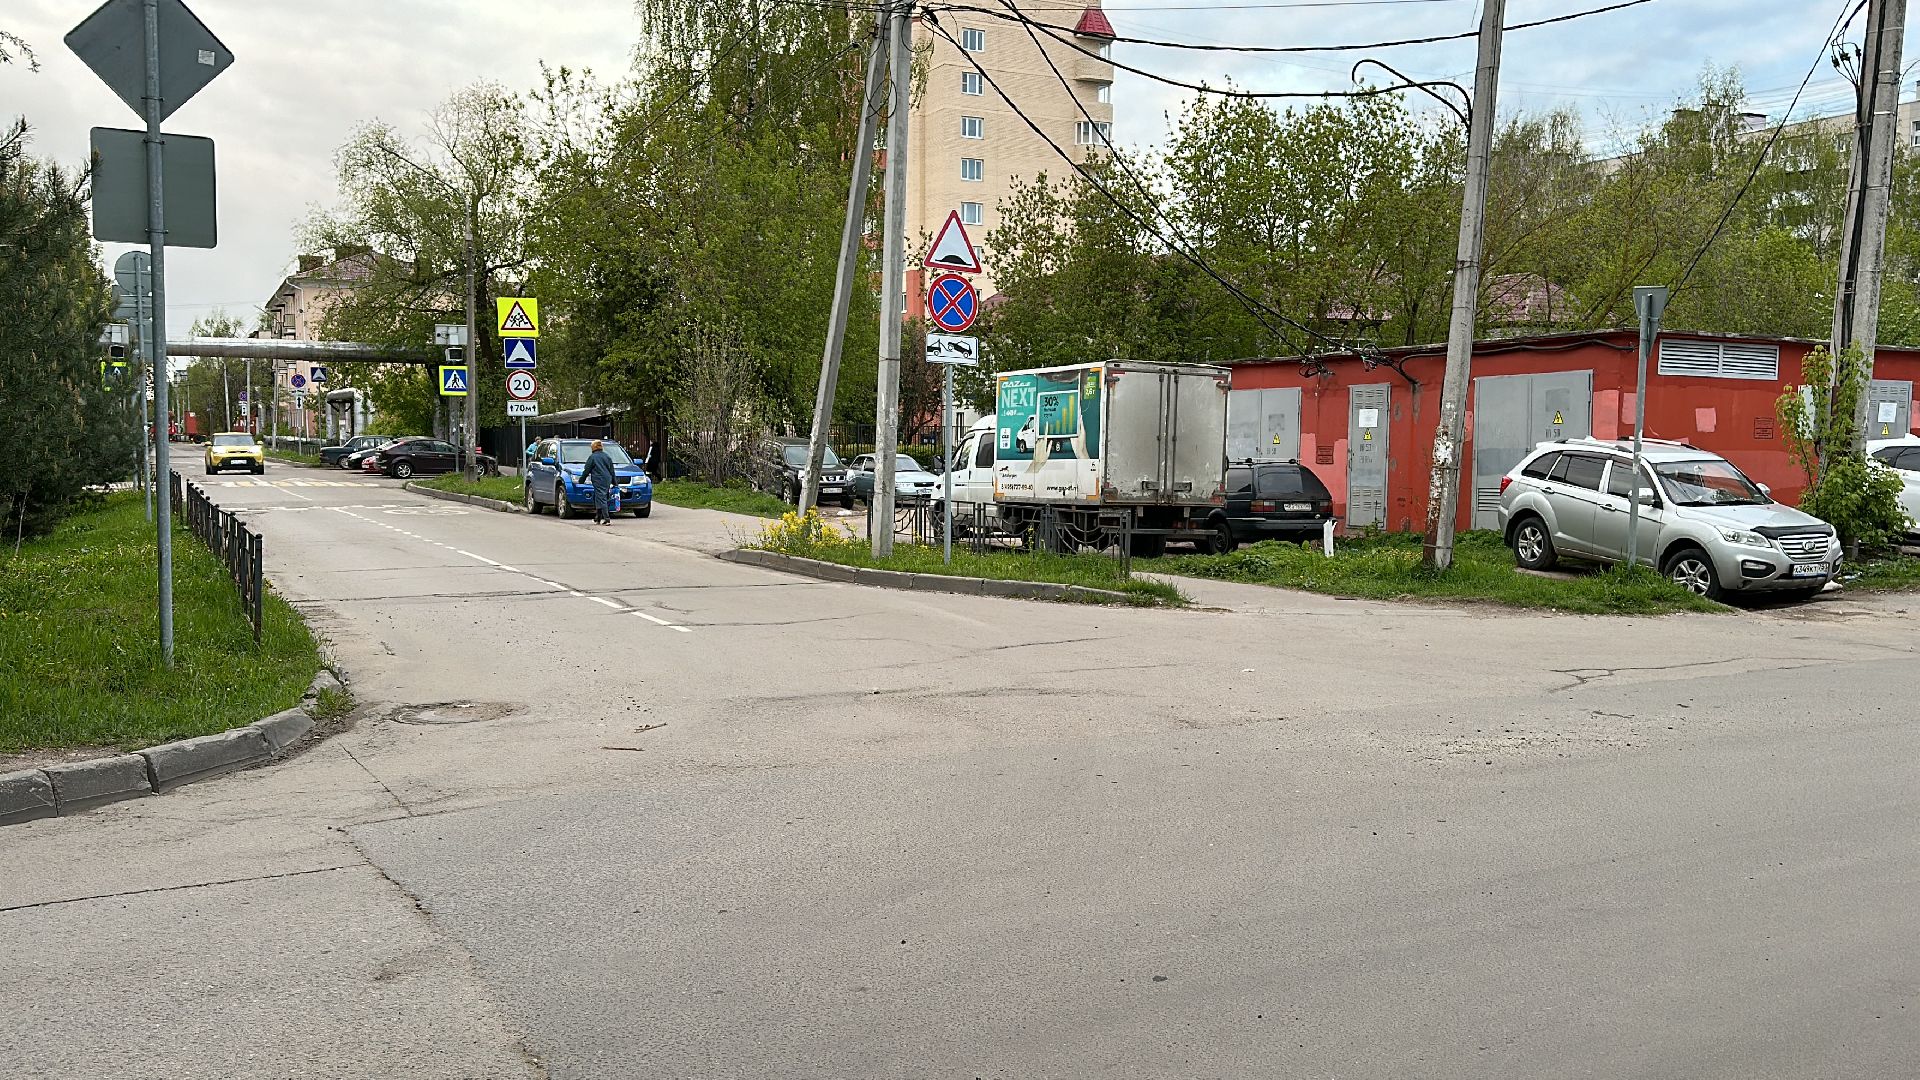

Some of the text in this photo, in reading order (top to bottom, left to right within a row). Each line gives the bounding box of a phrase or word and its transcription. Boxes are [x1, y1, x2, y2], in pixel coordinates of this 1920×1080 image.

[513, 379, 531, 391] 20
[1001, 387, 1037, 408] NEXT
[1043, 395, 1060, 407] 30%
[514, 404, 532, 412] 70м
